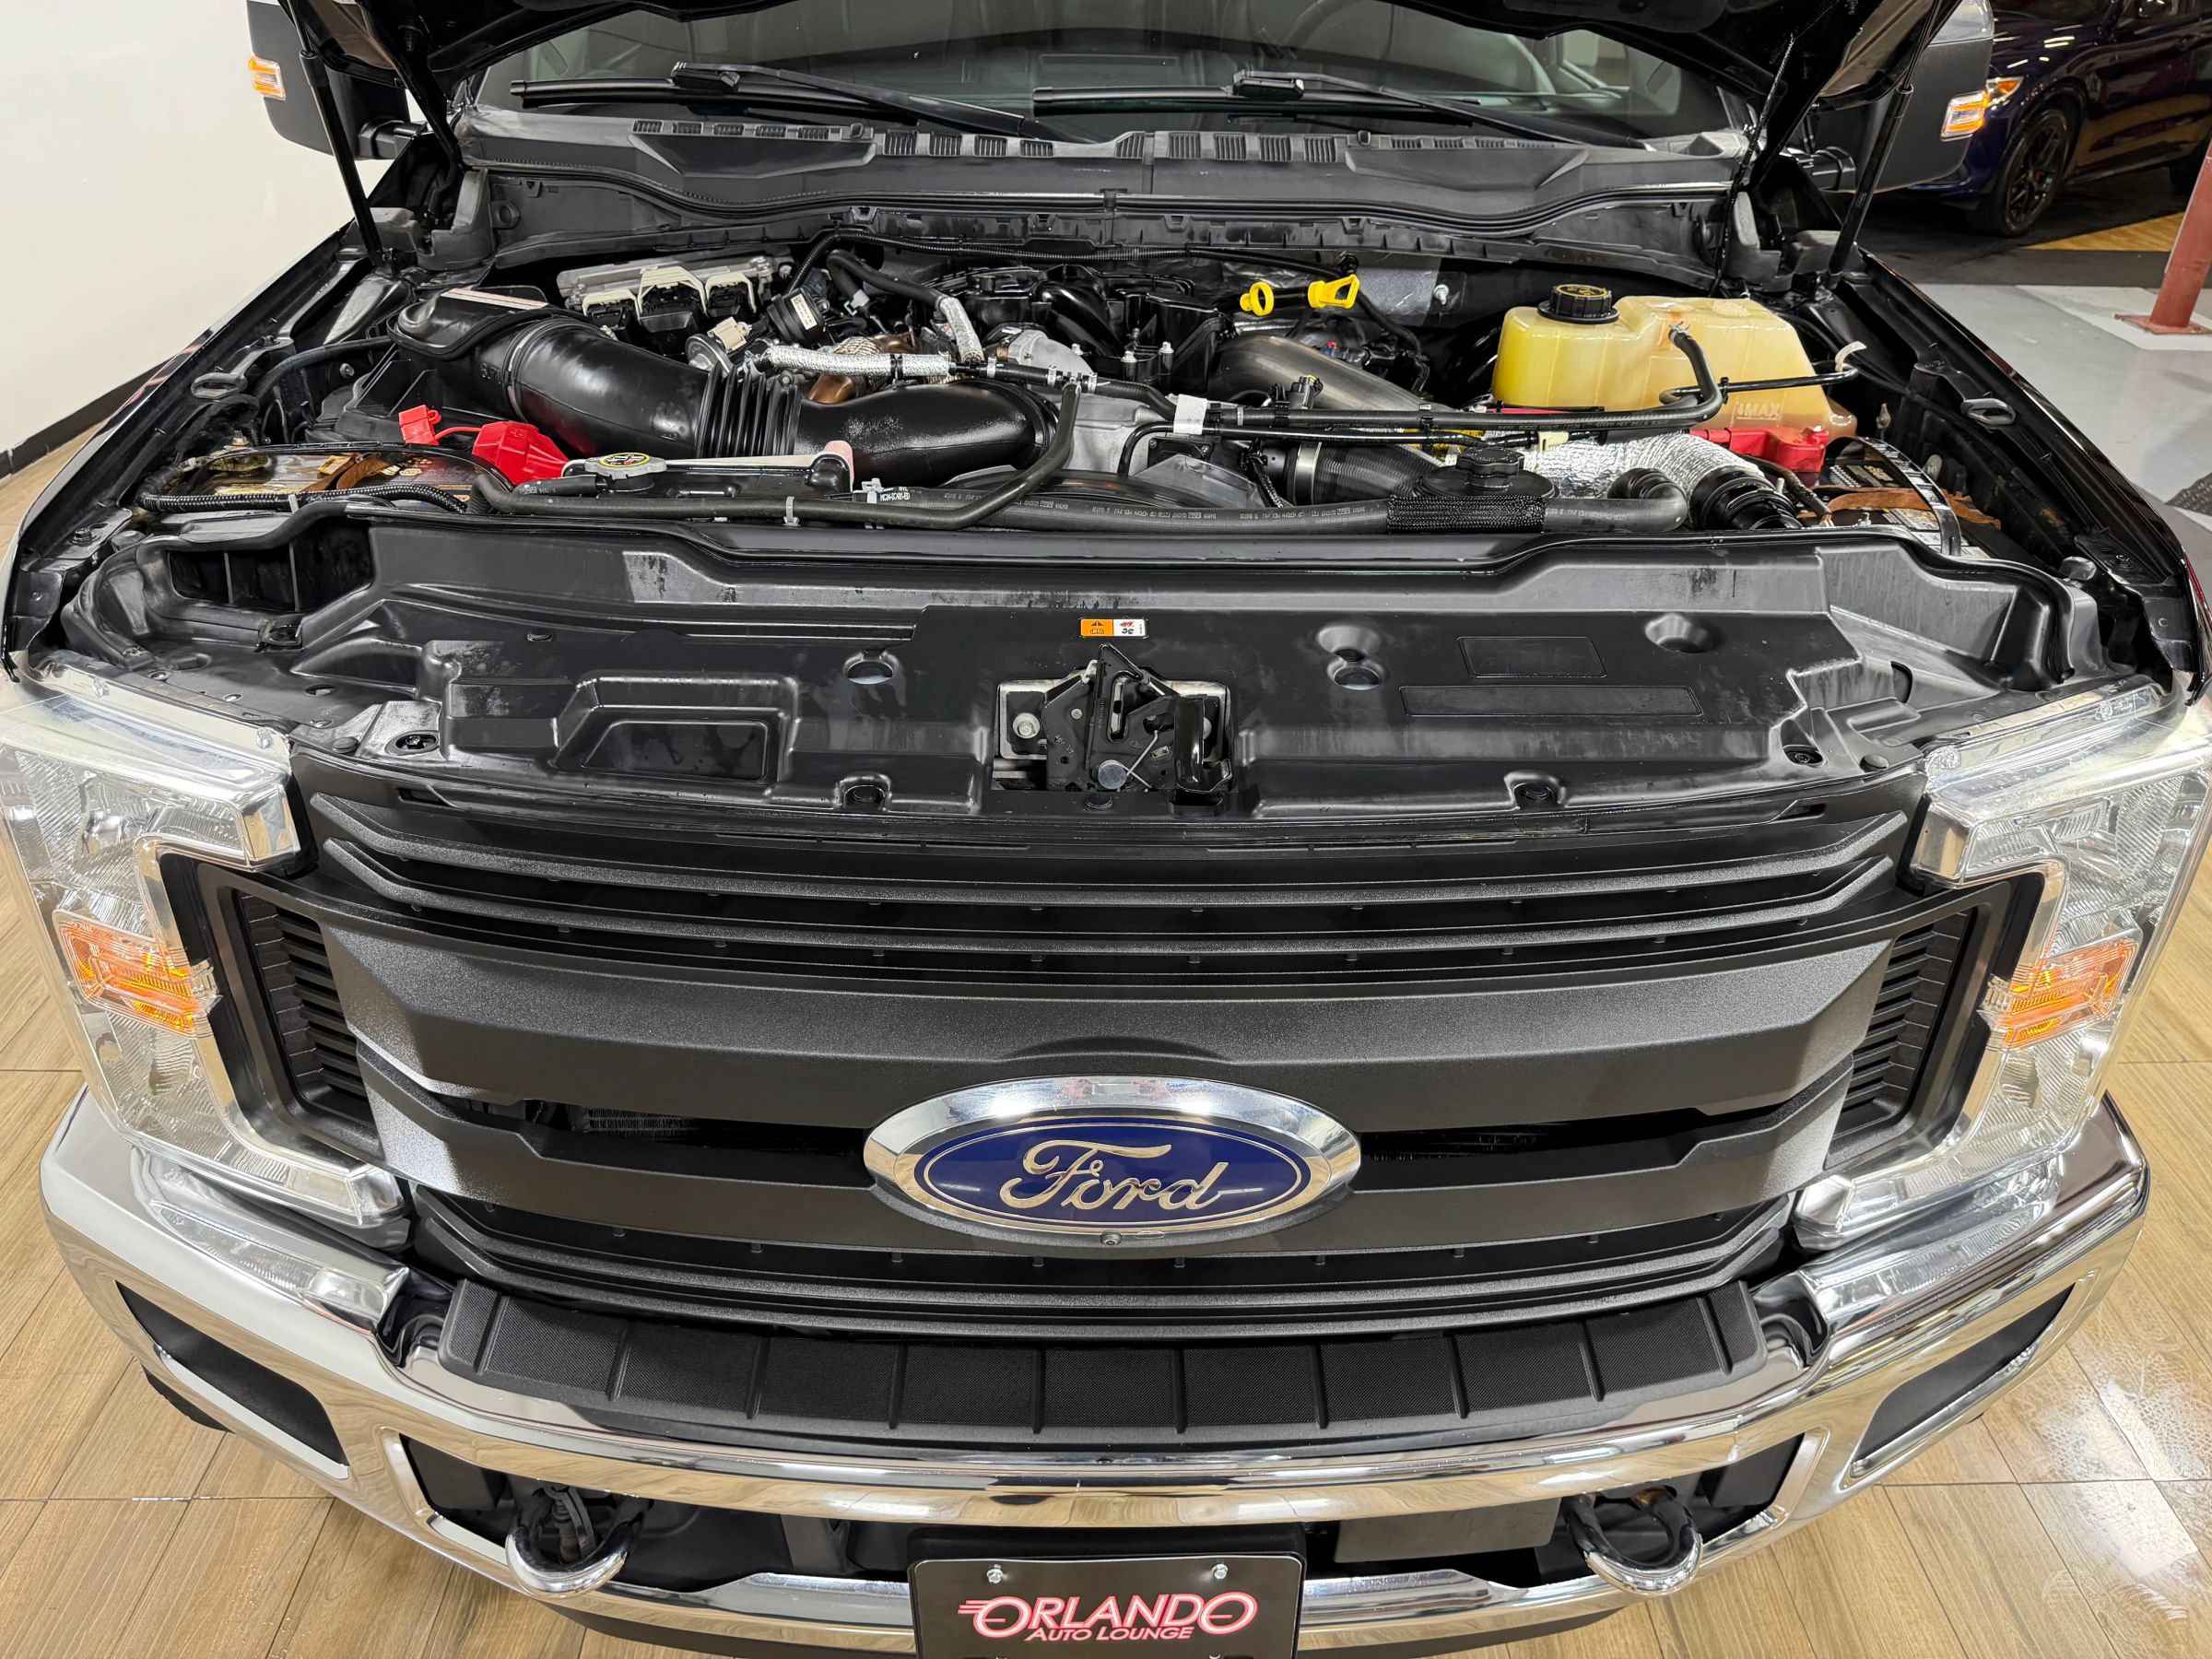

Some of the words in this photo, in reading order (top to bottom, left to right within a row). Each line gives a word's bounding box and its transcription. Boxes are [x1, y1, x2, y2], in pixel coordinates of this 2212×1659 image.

[1000, 1139, 1230, 1211] Ford
[959, 1592, 1258, 1638] ORLANDO
[1024, 1627, 1093, 1642] AUTO
[1095, 1626, 1194, 1641] LOUNGE
